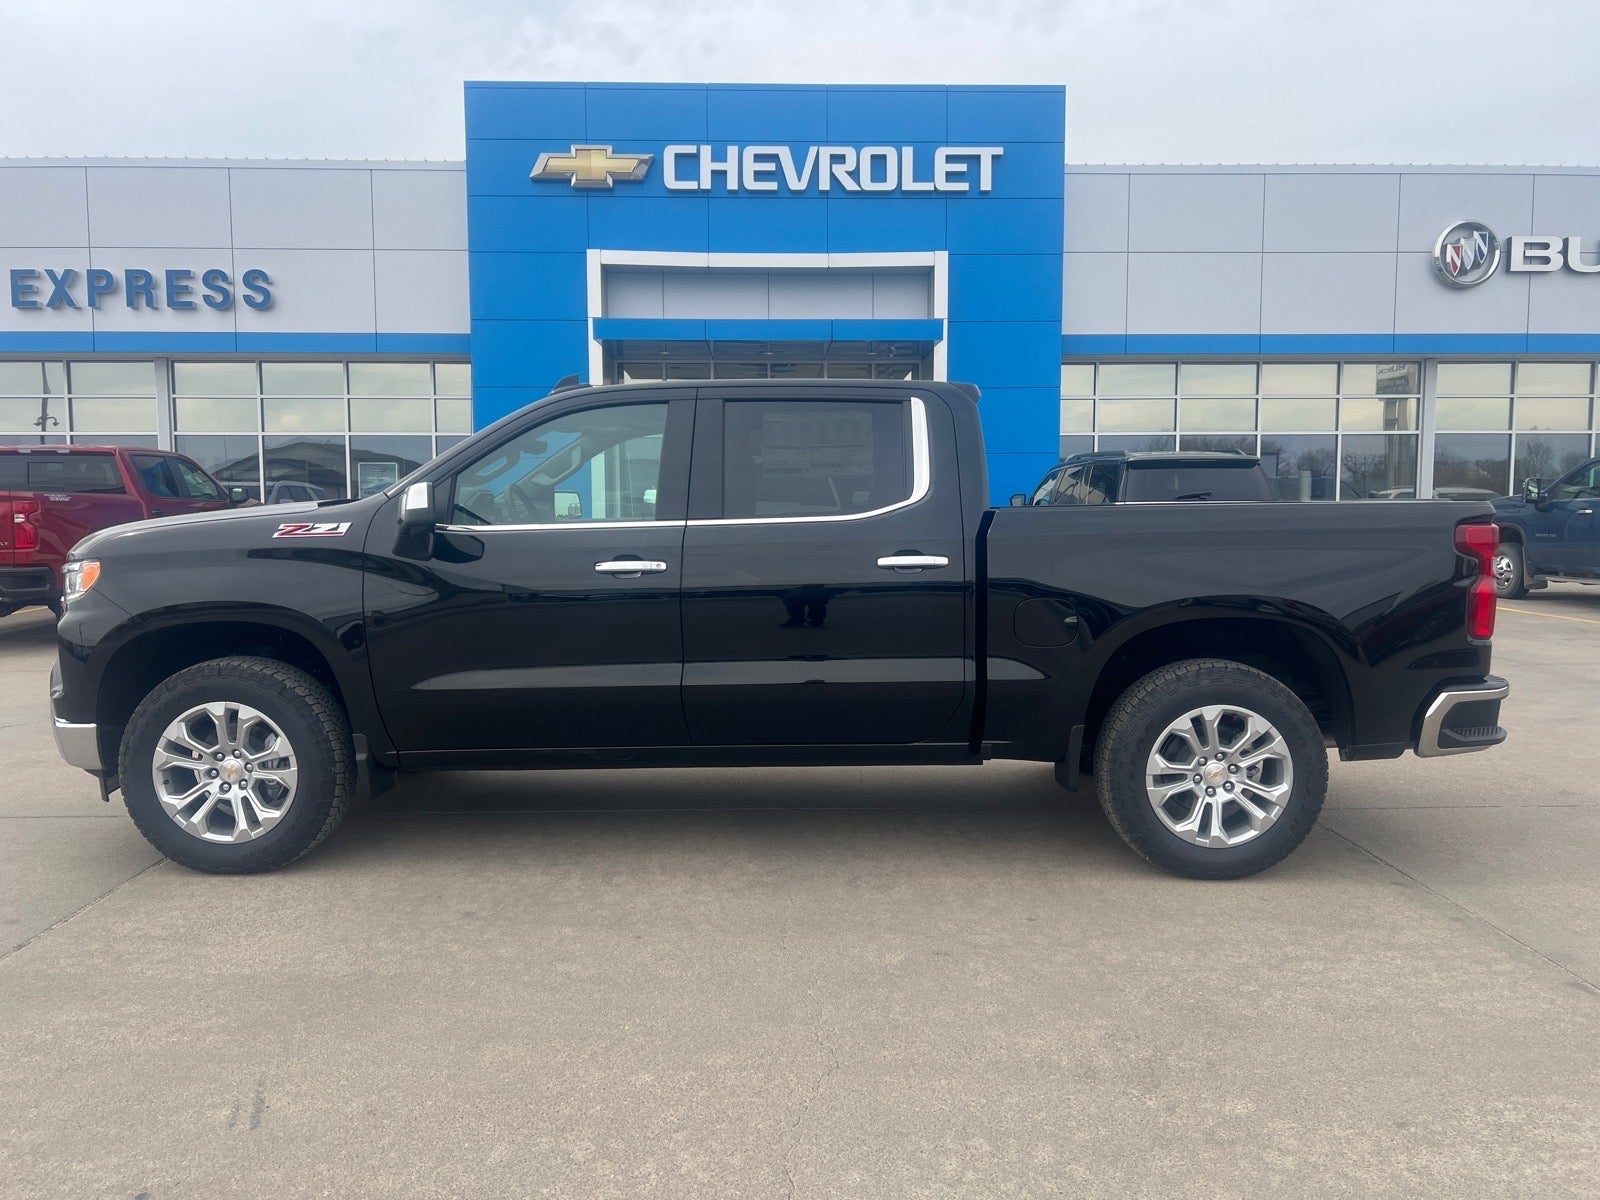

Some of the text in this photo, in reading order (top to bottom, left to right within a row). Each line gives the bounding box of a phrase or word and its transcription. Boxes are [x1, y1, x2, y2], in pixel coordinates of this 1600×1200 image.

[663, 145, 1004, 192] CHEVROLET
[1508, 235, 1600, 273] BU
[9, 268, 275, 310] EXPRESS
[272, 522, 352, 538] Z71
